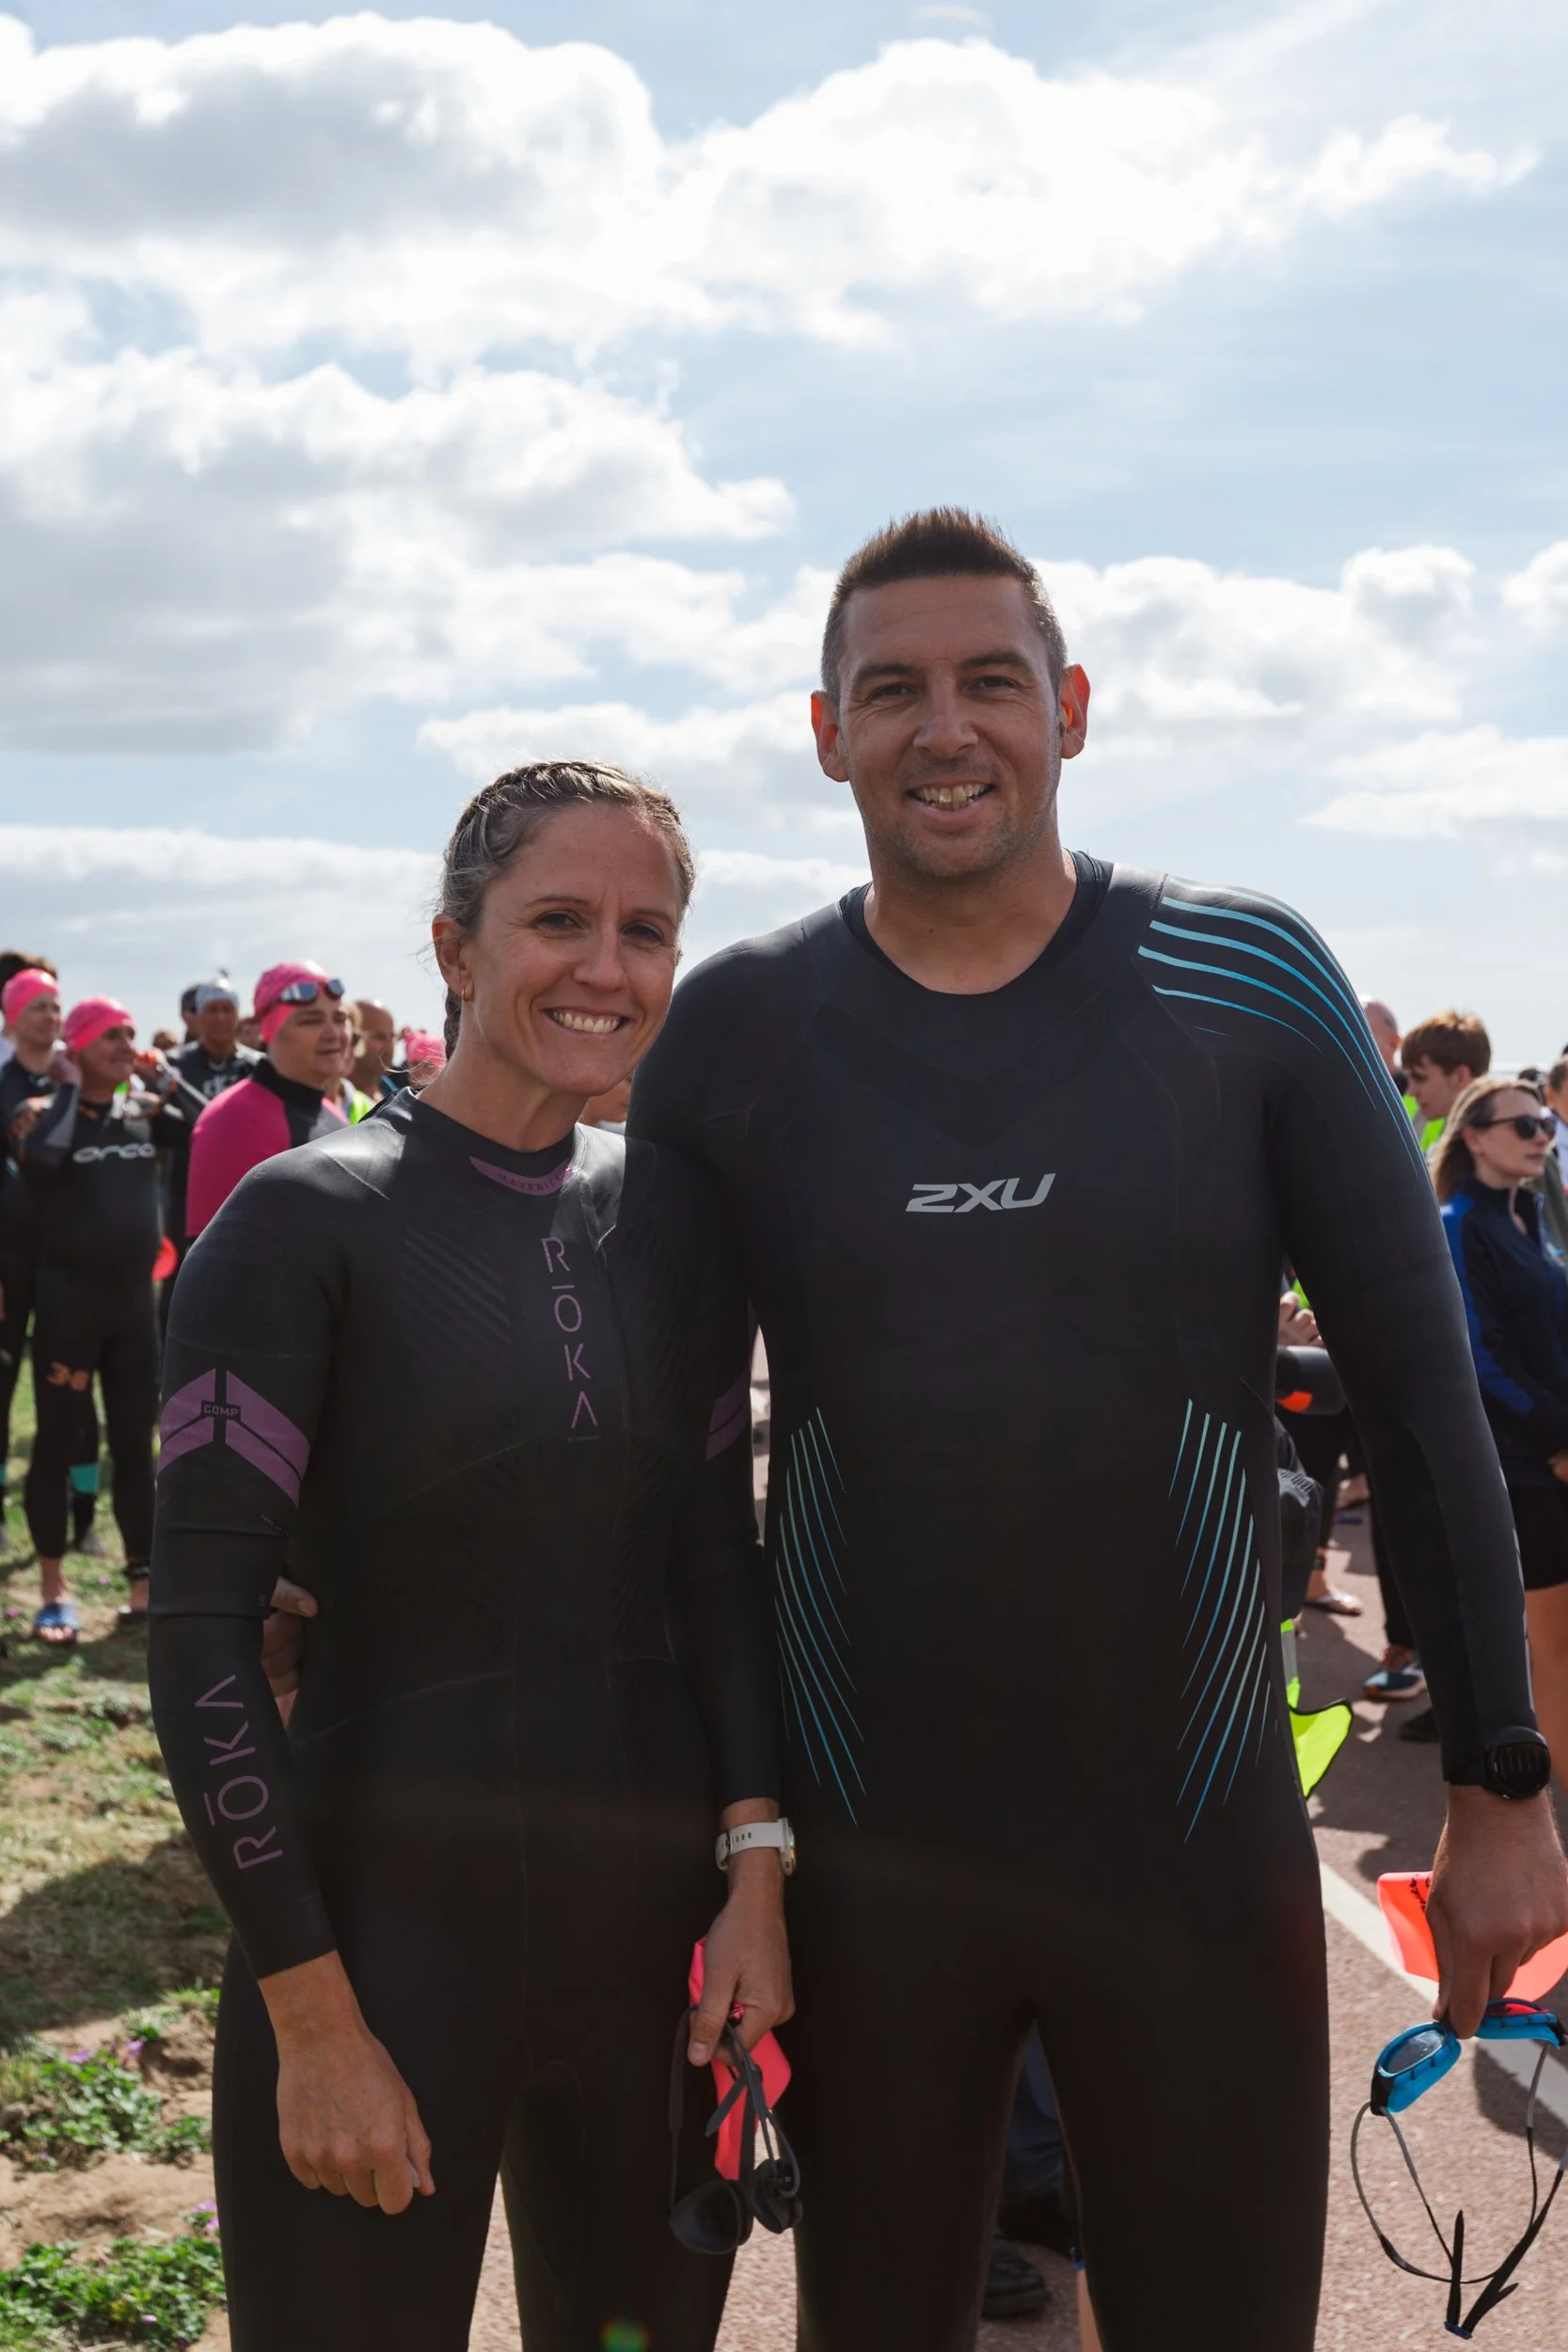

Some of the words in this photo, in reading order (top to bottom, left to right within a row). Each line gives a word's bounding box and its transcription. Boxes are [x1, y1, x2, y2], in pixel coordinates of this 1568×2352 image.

[72, 1142, 156, 1164] orca
[905, 1172, 1056, 1213] 2XU
[203, 1404, 239, 1418] COMP
